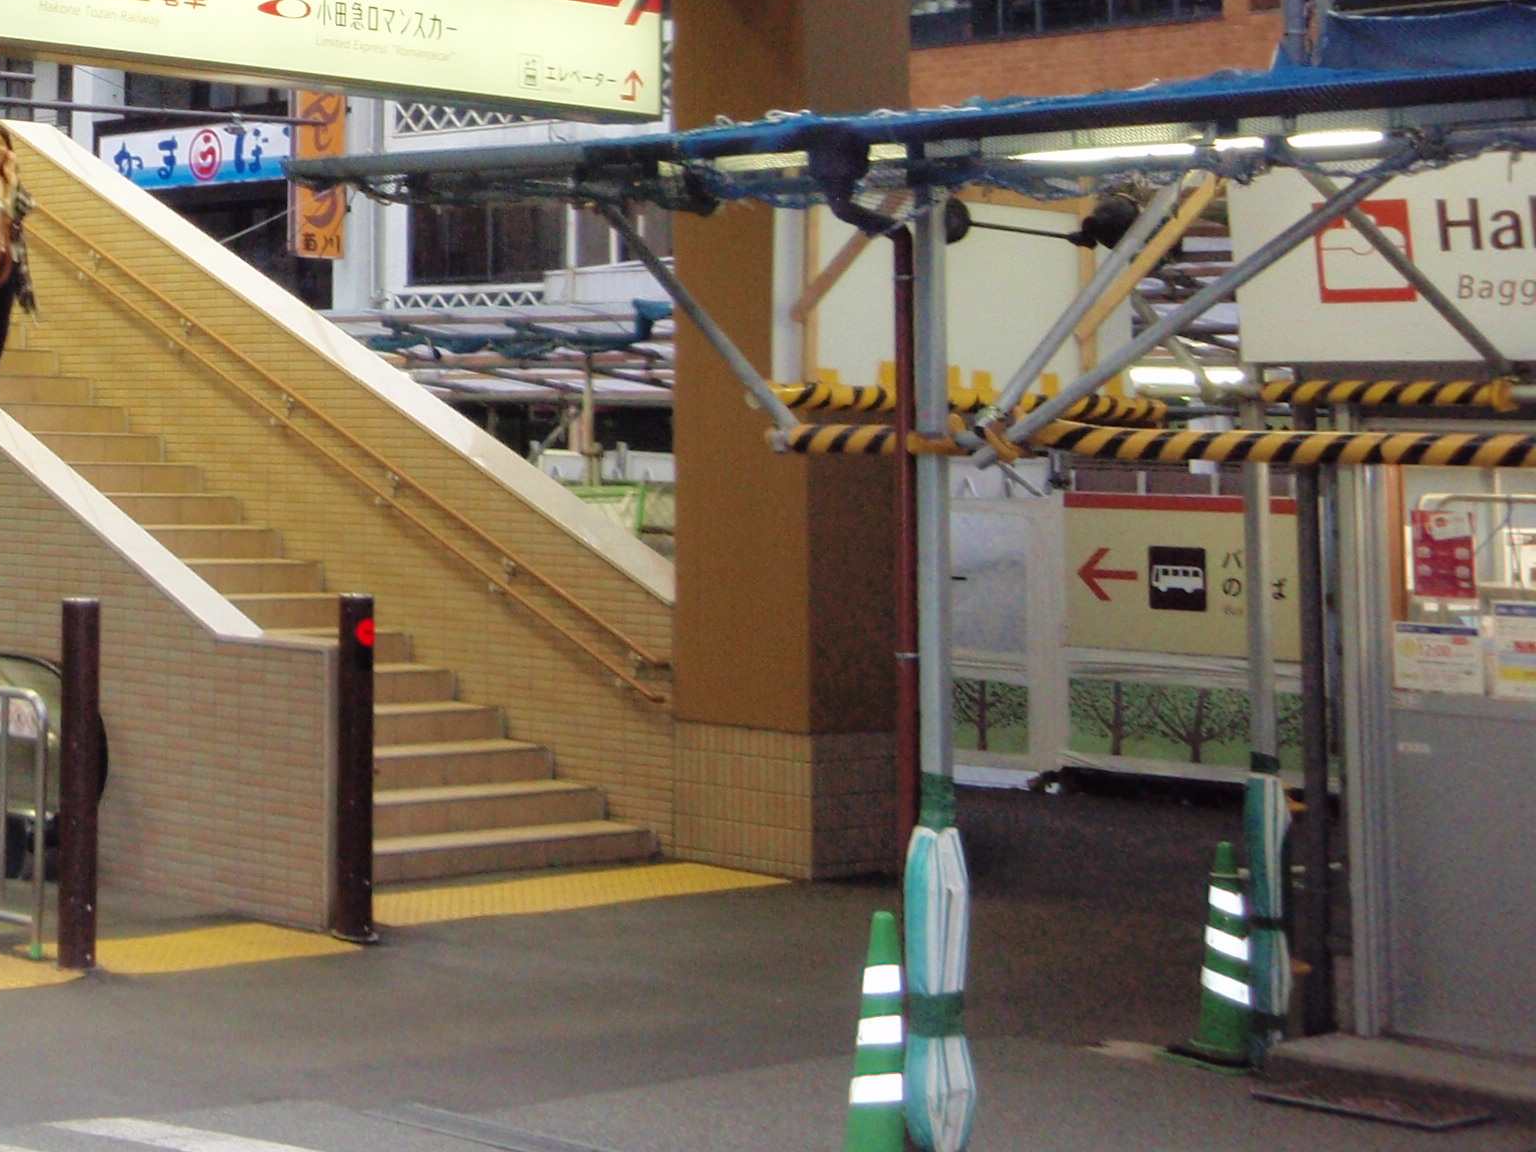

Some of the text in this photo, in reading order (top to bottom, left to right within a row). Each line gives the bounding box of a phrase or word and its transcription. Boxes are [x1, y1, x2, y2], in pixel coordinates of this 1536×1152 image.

[38, 0, 162, 28] Hakone Tozan Railway
[545, 65, 618, 87] エレベーター
